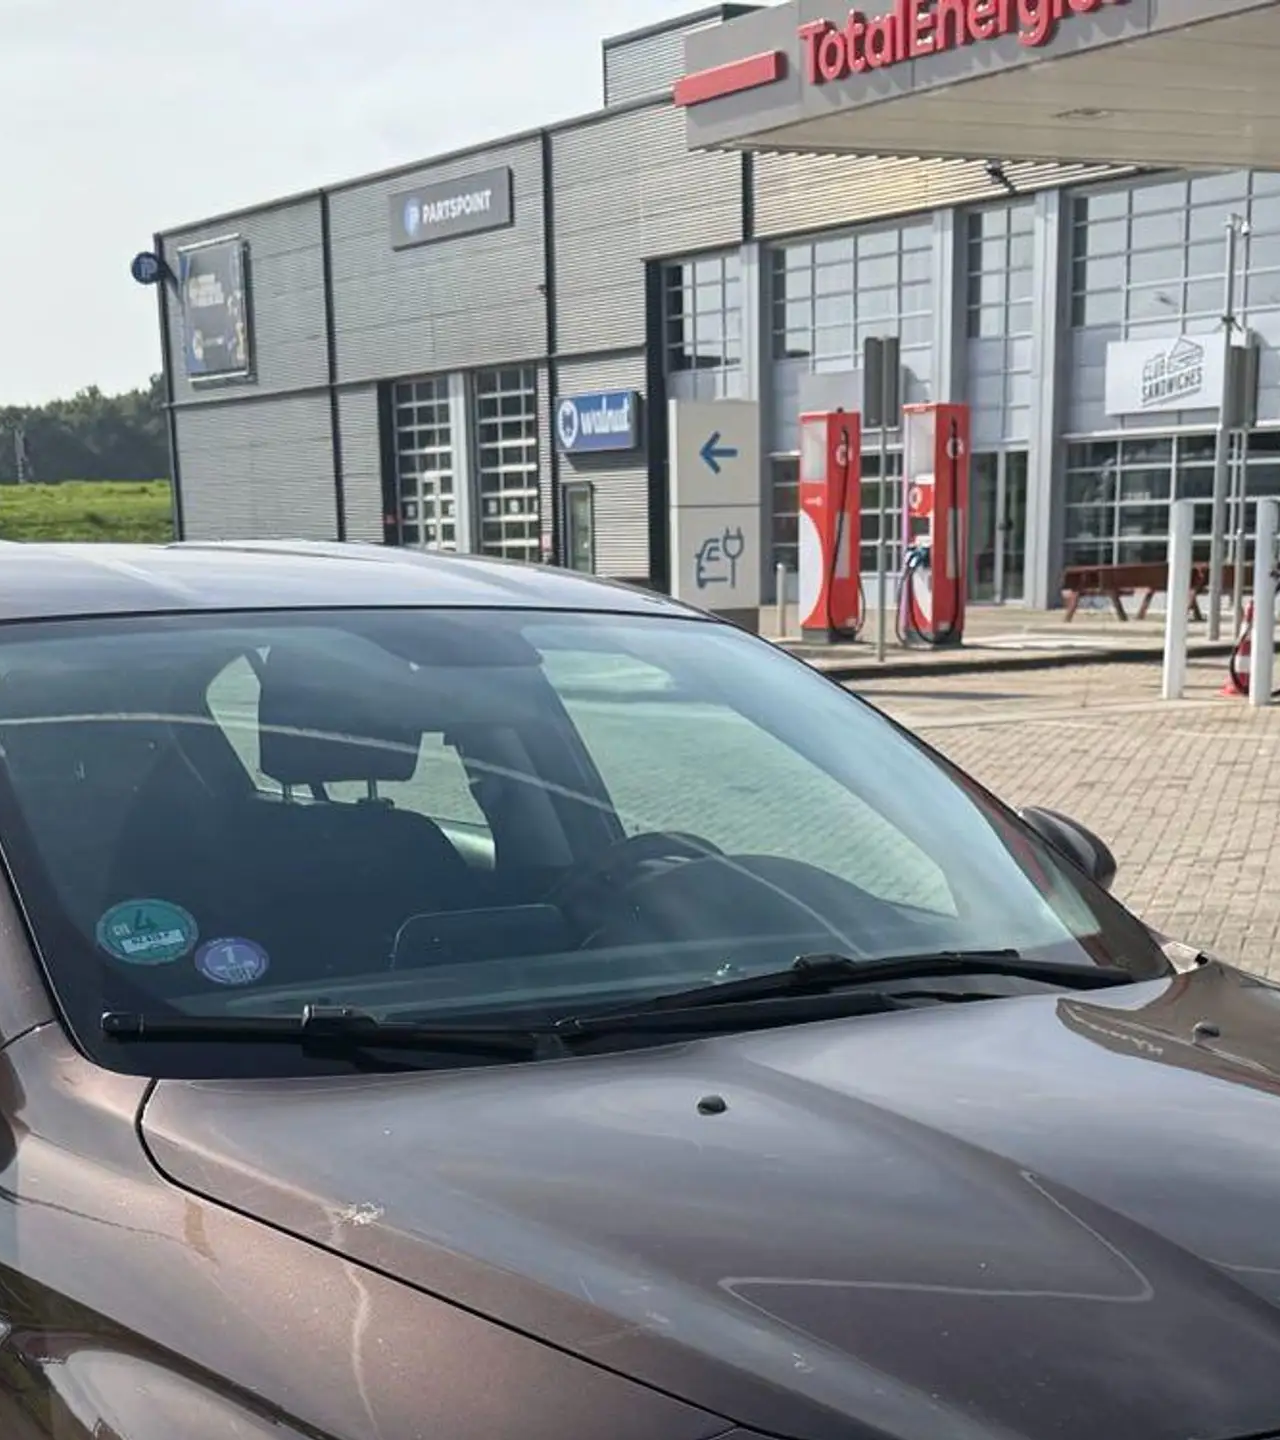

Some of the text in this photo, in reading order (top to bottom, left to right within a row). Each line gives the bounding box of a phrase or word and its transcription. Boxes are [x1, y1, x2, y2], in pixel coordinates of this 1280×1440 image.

[797, 0, 1116, 84] TotalEnerg
[422, 189, 492, 224] PARTSPOINT
[1142, 366, 1202, 403] SANDWICHES
[581, 395, 631, 436] walnut
